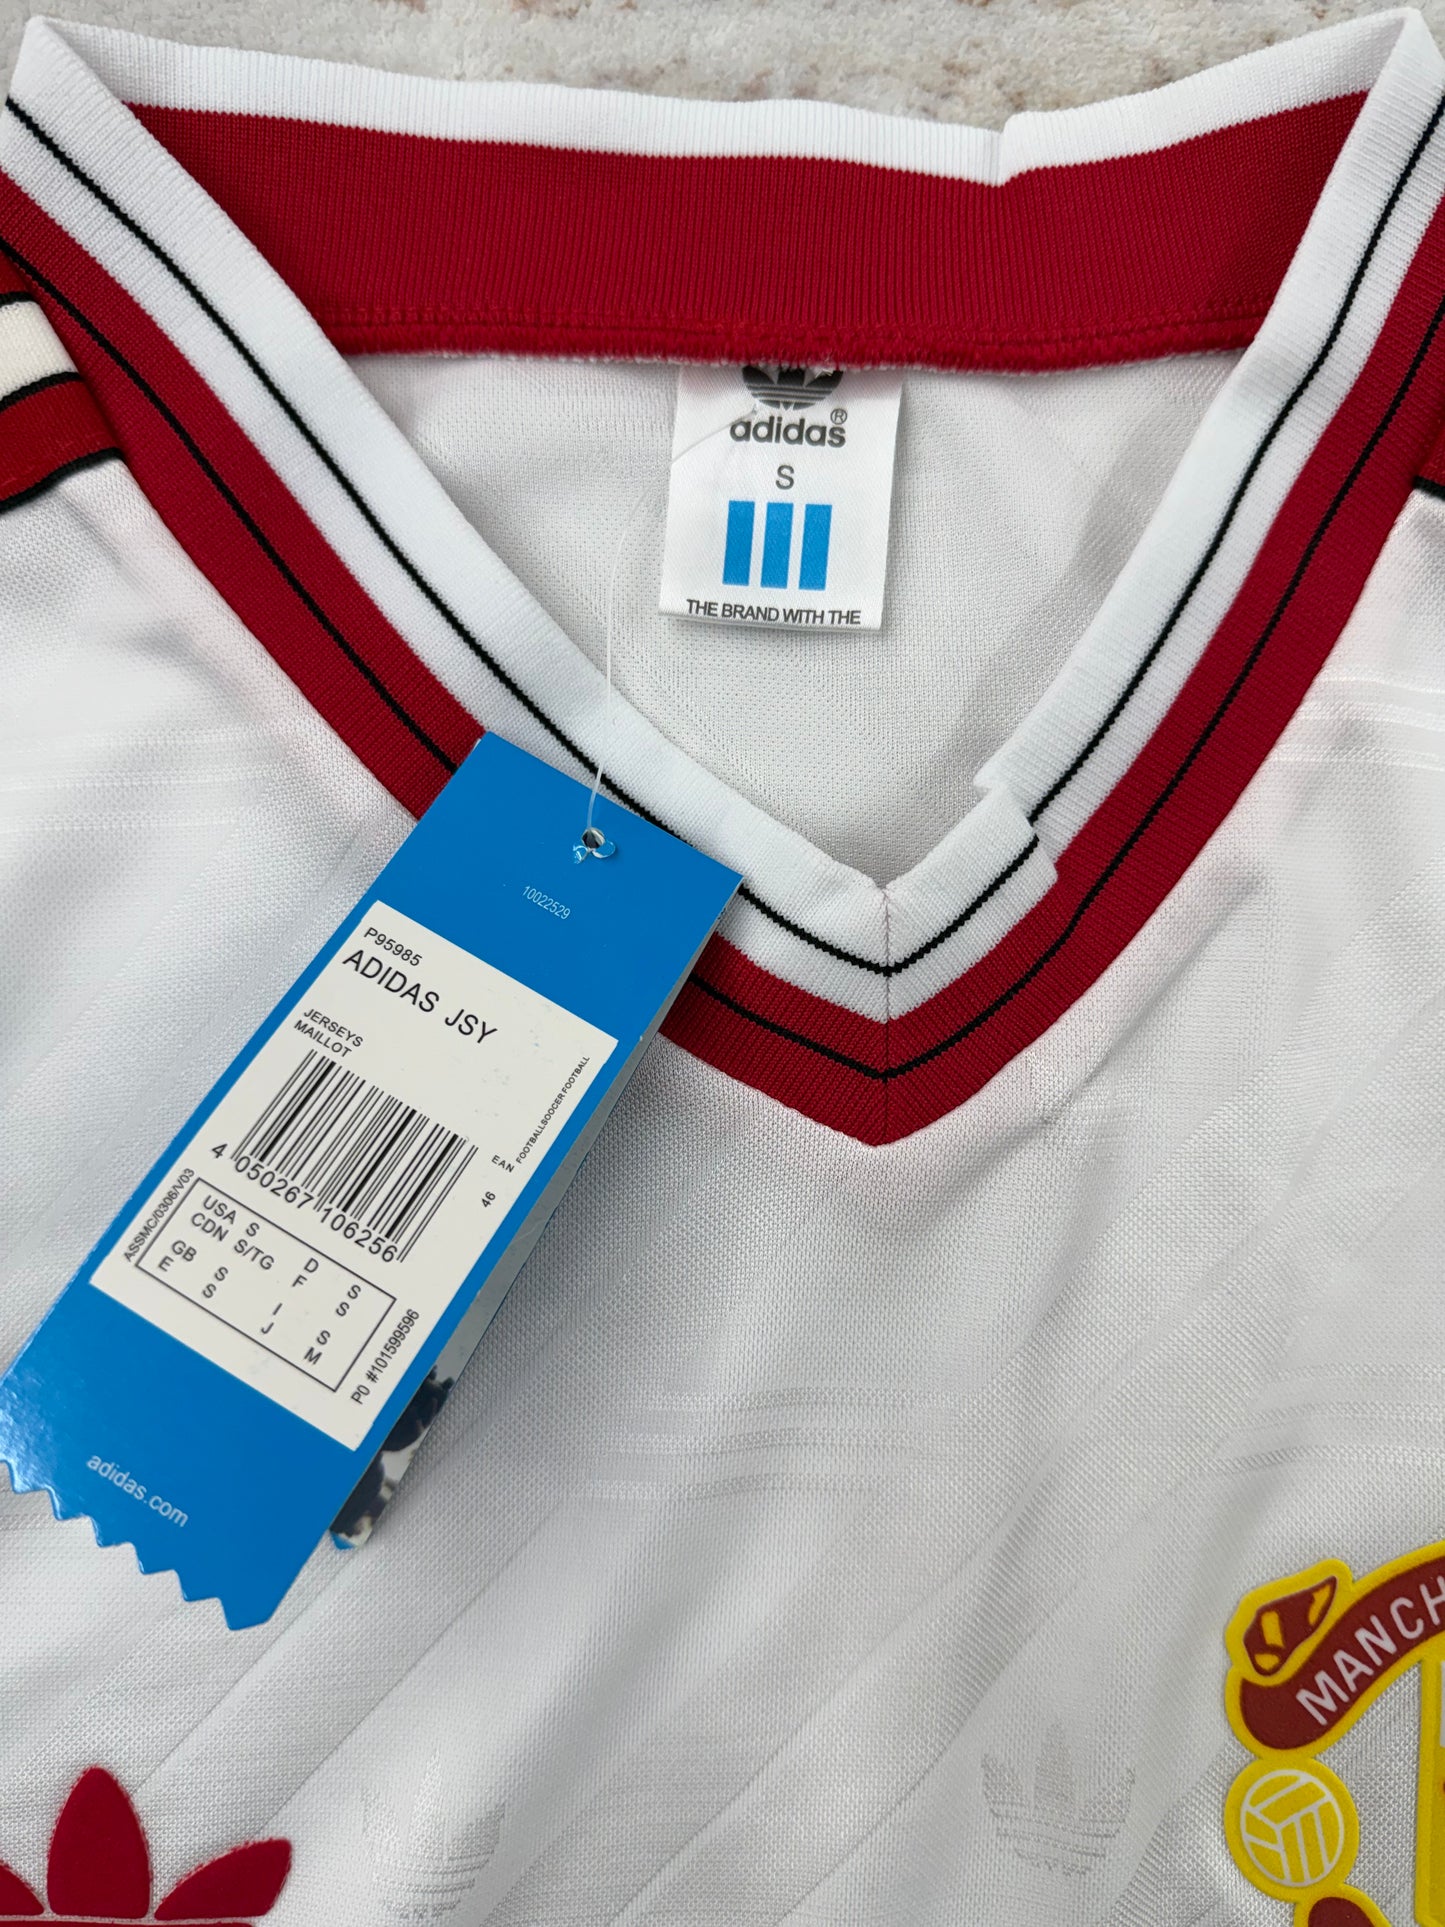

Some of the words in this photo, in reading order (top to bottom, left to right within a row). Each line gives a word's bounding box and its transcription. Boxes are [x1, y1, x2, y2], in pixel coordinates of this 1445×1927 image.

[775, 464, 794, 490] S
[687, 599, 718, 617] THE
[721, 603, 780, 622] BRAND
[782, 608, 824, 624] WITH
[828, 610, 861, 625] THE
[522, 885, 571, 920] 10022529
[363, 927, 422, 966] P95985
[342, 949, 440, 1013] ADIDAS
[444, 1009, 498, 1044] JSY
[294, 1019, 352, 1058] MAILLOT
[303, 1008, 363, 1047] JERSEYS
[561, 1056, 590, 1094] FOOTBALL
[491, 1154, 515, 1173] EAN
[211, 1142, 228, 1159] 4
[235, 1155, 314, 1210] 050267
[320, 1207, 397, 1264] 106256
[481, 1191, 496, 1208] 46
[190, 1213, 229, 1242] CDN
[234, 1239, 274, 1270] S/TG
[291, 1275, 307, 1289] F
[336, 1302, 349, 1317] S
[203, 1194, 237, 1225] USA
[246, 1222, 260, 1237] S
[304, 1258, 319, 1273] D
[347, 1285, 361, 1300] S
[158, 1256, 174, 1272] E
[202, 1284, 216, 1299] S
[261, 1322, 274, 1335] J
[303, 1347, 322, 1366] M
[171, 1240, 197, 1262] GB
[214, 1266, 229, 1282] S
[317, 1330, 331, 1345] S
[366, 1309, 420, 1384] #101599596
[86, 1455, 188, 1528] adidas.com
